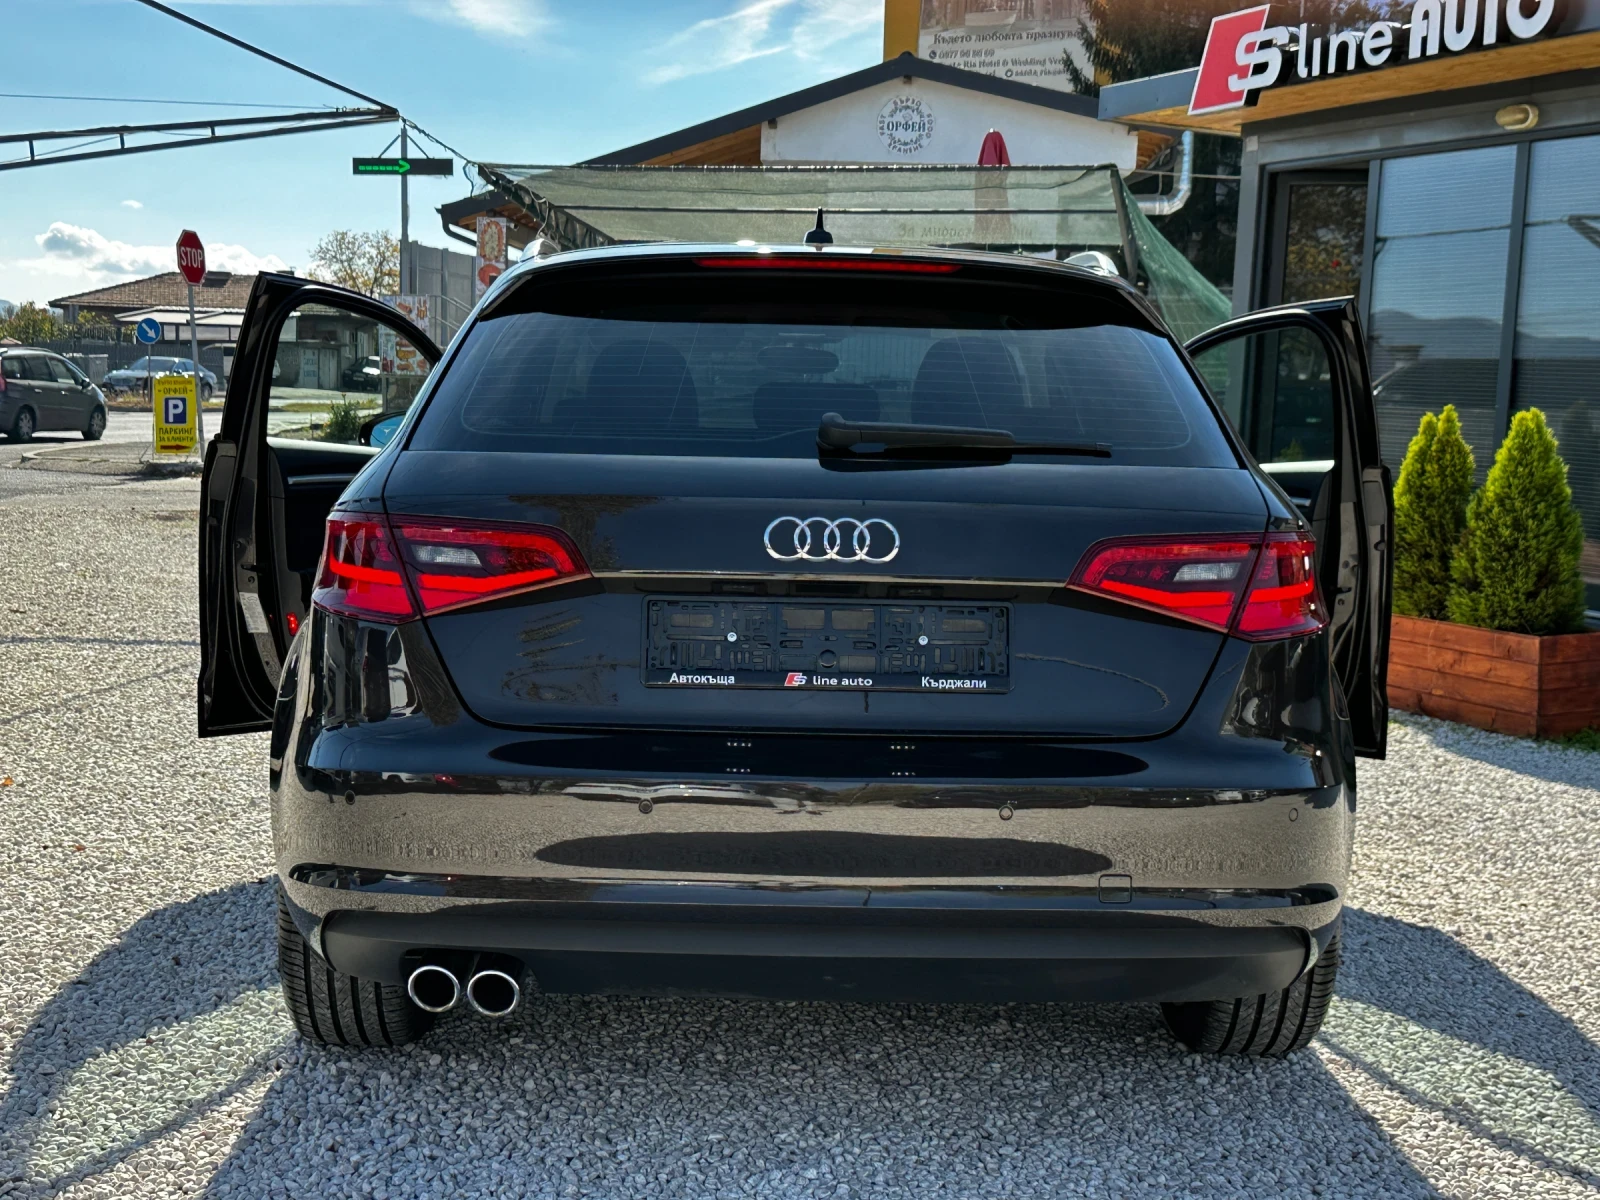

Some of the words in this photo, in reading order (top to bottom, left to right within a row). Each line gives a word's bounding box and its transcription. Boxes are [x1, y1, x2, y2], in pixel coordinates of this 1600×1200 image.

[1297, 22, 1392, 79] line
[886, 119, 926, 132] ОРФЕЙ
[180, 247, 203, 269] STOP
[163, 386, 188, 394] ОРФЕЙ
[168, 399, 184, 423] P
[158, 427, 194, 435] ПАРКИНГ
[669, 672, 735, 687] Автокъща
[812, 675, 838, 686] line
[841, 677, 873, 686] auto
[921, 676, 987, 689] Кърджали
